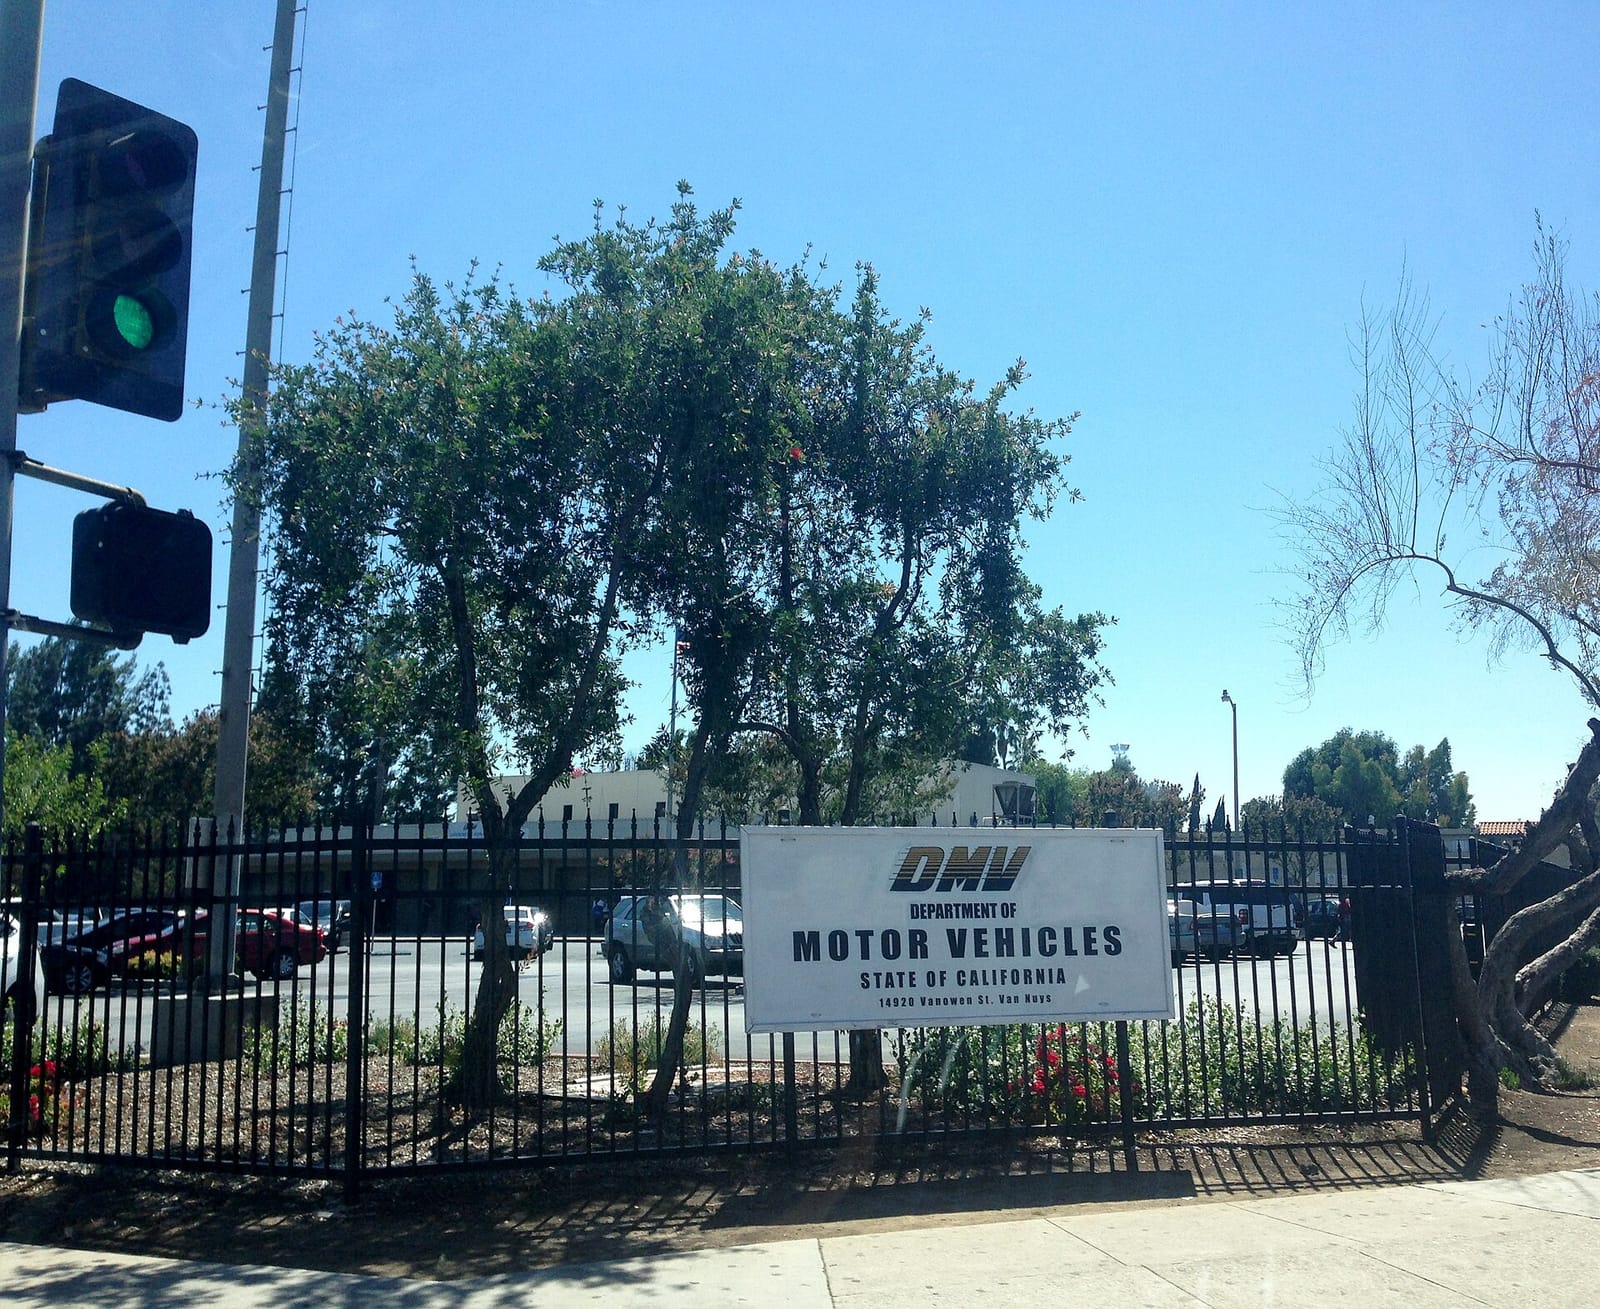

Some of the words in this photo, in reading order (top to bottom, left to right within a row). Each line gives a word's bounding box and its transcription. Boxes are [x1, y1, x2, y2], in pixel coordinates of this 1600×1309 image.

[890, 846, 1032, 892] DMV
[910, 903, 998, 920] DEPARTMENT
[1000, 902, 1017, 919] OF
[792, 929, 929, 962] MOTOR
[946, 925, 1122, 959] VEHICLES
[860, 971, 916, 989] STATE
[926, 970, 947, 987] OF
[956, 967, 1066, 987] CALIFORNIA
[879, 997, 915, 1008] 14920
[920, 996, 973, 1007] Vanowen
[977, 994, 994, 1005] St.
[999, 994, 1020, 1004] Van
[1024, 993, 1052, 1004] Nuys
